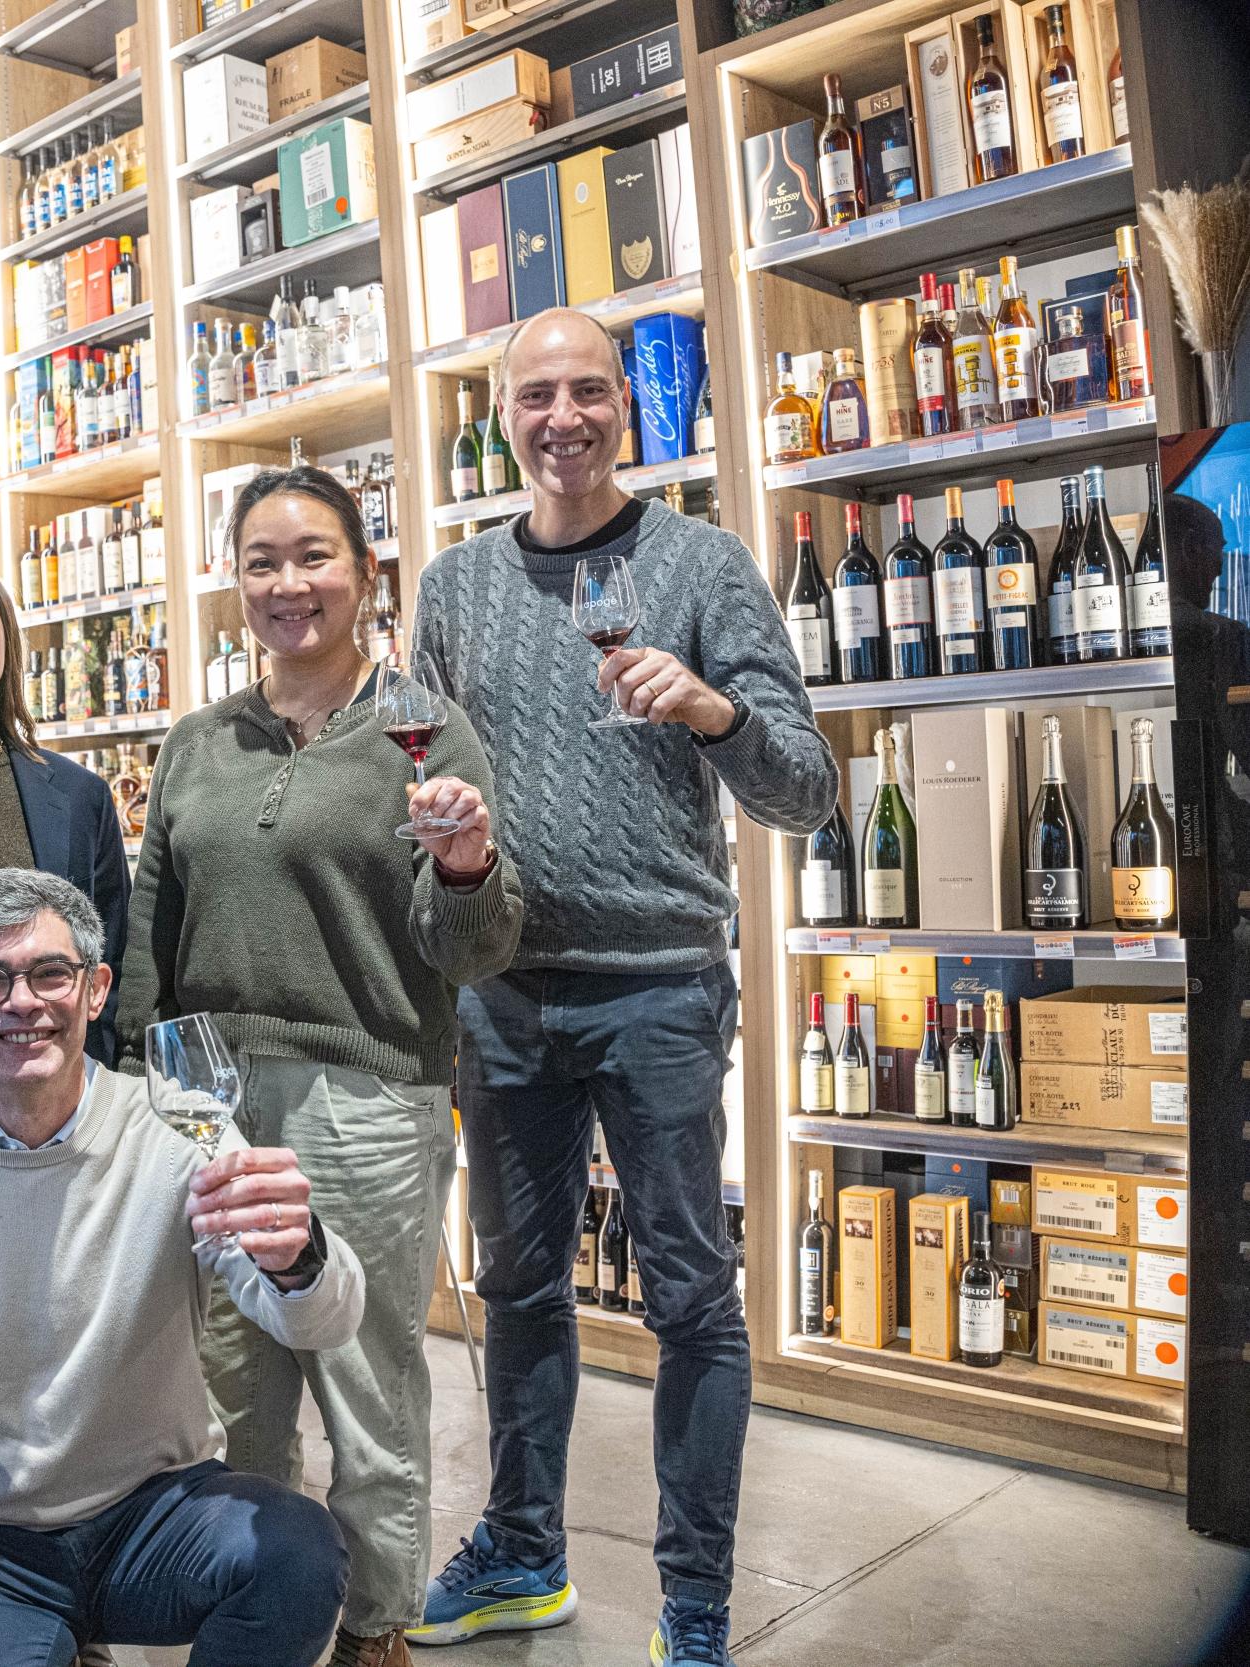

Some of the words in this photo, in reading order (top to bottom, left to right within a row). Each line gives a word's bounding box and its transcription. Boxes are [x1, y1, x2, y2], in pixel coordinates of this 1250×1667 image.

[279, 88, 312, 109] FRAGILE
[767, 191, 800, 207] Hennessy
[836, 406, 853, 415] HINE
[921, 776, 943, 786] LOUIS
[944, 775, 982, 785] ROEDERER
[960, 1286, 990, 1297] ORIO
[965, 1300, 991, 1309] SALA
